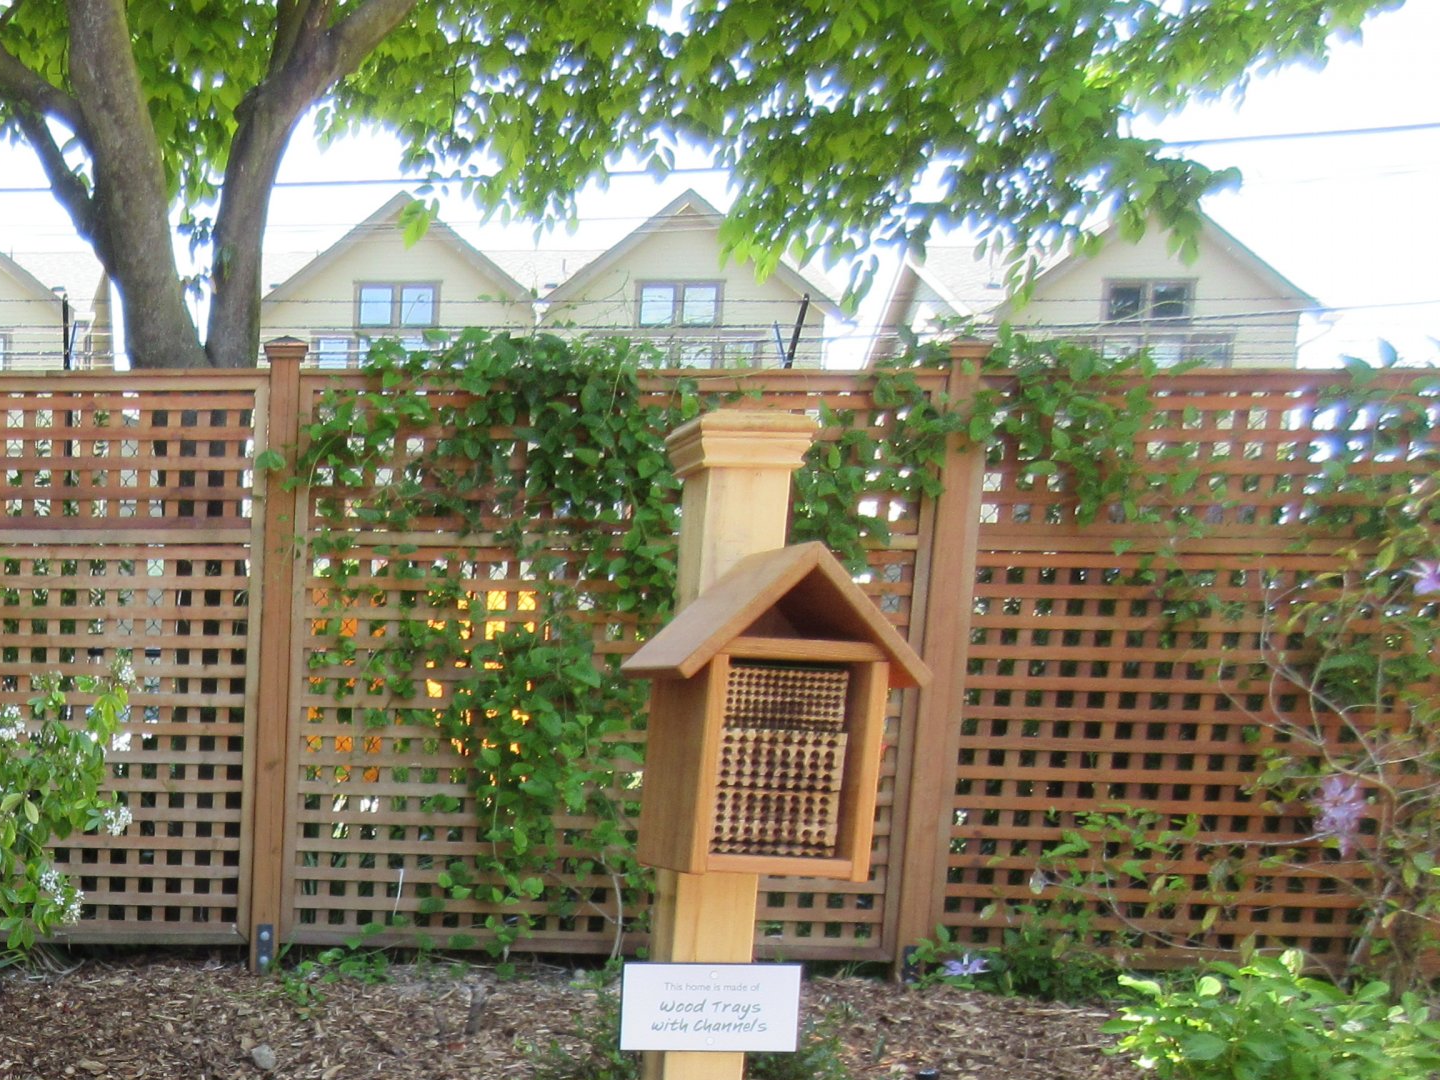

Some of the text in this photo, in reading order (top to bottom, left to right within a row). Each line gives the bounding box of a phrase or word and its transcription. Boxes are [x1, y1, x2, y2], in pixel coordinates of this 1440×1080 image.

[664, 982, 761, 992] This home is made of
[660, 999, 761, 1020] Wood Trays
[651, 1018, 767, 1032] with Channels
